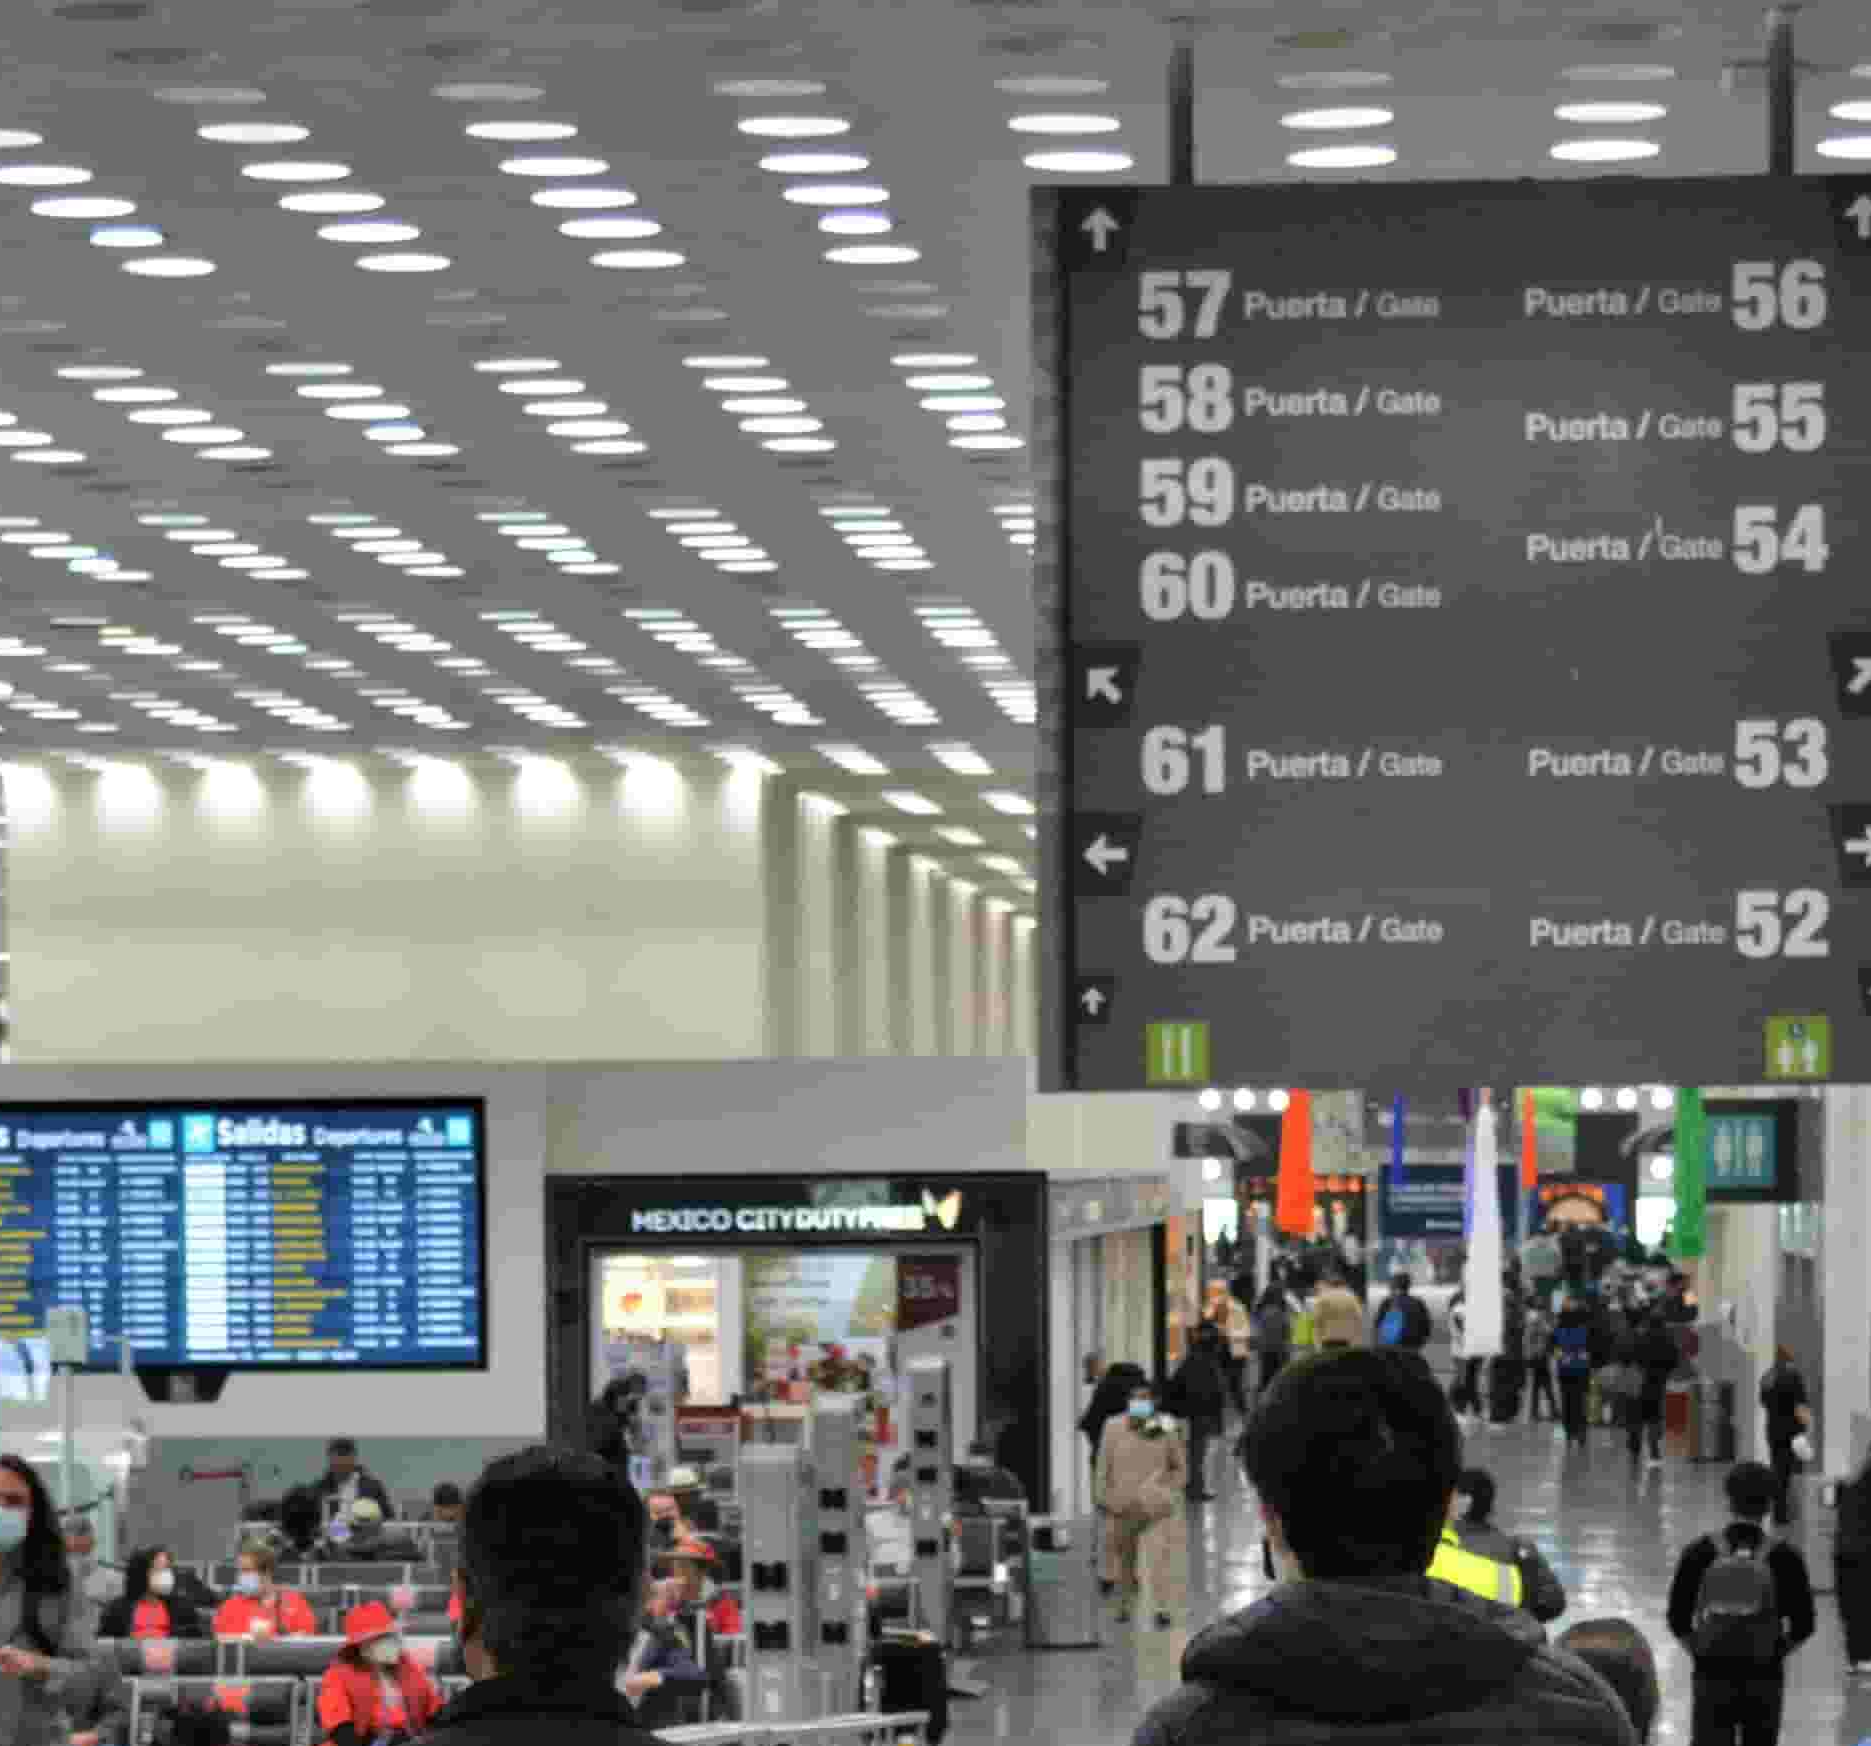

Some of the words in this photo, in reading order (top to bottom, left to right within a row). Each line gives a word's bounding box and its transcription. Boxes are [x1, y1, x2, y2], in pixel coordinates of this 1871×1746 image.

[1138, 271, 1230, 338] 57
[1245, 291, 1347, 320] Puerta
[1377, 292, 1440, 318] Gate
[1525, 287, 1628, 317] Puerta
[1658, 289, 1722, 314] Gate
[1734, 262, 1825, 329] 56
[1141, 366, 1232, 433] 58
[1245, 388, 1348, 417] Puerta
[1377, 389, 1441, 416] Gate
[1525, 412, 1629, 441] Puerta
[1658, 414, 1722, 439] Gate
[1734, 383, 1825, 451] 55
[1142, 459, 1233, 526] 59
[1246, 485, 1348, 513] Puerta
[1378, 486, 1441, 512] Gate
[1527, 533, 1630, 561] Puerta
[1660, 535, 1723, 560] Gate
[1735, 505, 1827, 573] 54
[1143, 552, 1234, 619] 60
[1246, 581, 1348, 609] Puerta
[1378, 583, 1441, 608] Gate
[1143, 725, 1225, 794] 61
[1247, 750, 1350, 780] Puerta
[1379, 751, 1443, 777] Gate
[1529, 748, 1632, 777] Puerta
[1661, 750, 1724, 775] Gate
[1736, 719, 1827, 787] 53
[1145, 895, 1235, 963] 62
[1248, 916, 1351, 944] Puerta
[1380, 917, 1443, 943] Gate
[1530, 917, 1632, 946] Puerta
[1662, 919, 1725, 945] Gate
[1736, 890, 1828, 957] 52
[218, 1118, 306, 1148] Salidas
[631, 1207, 731, 1231] MEXICO
